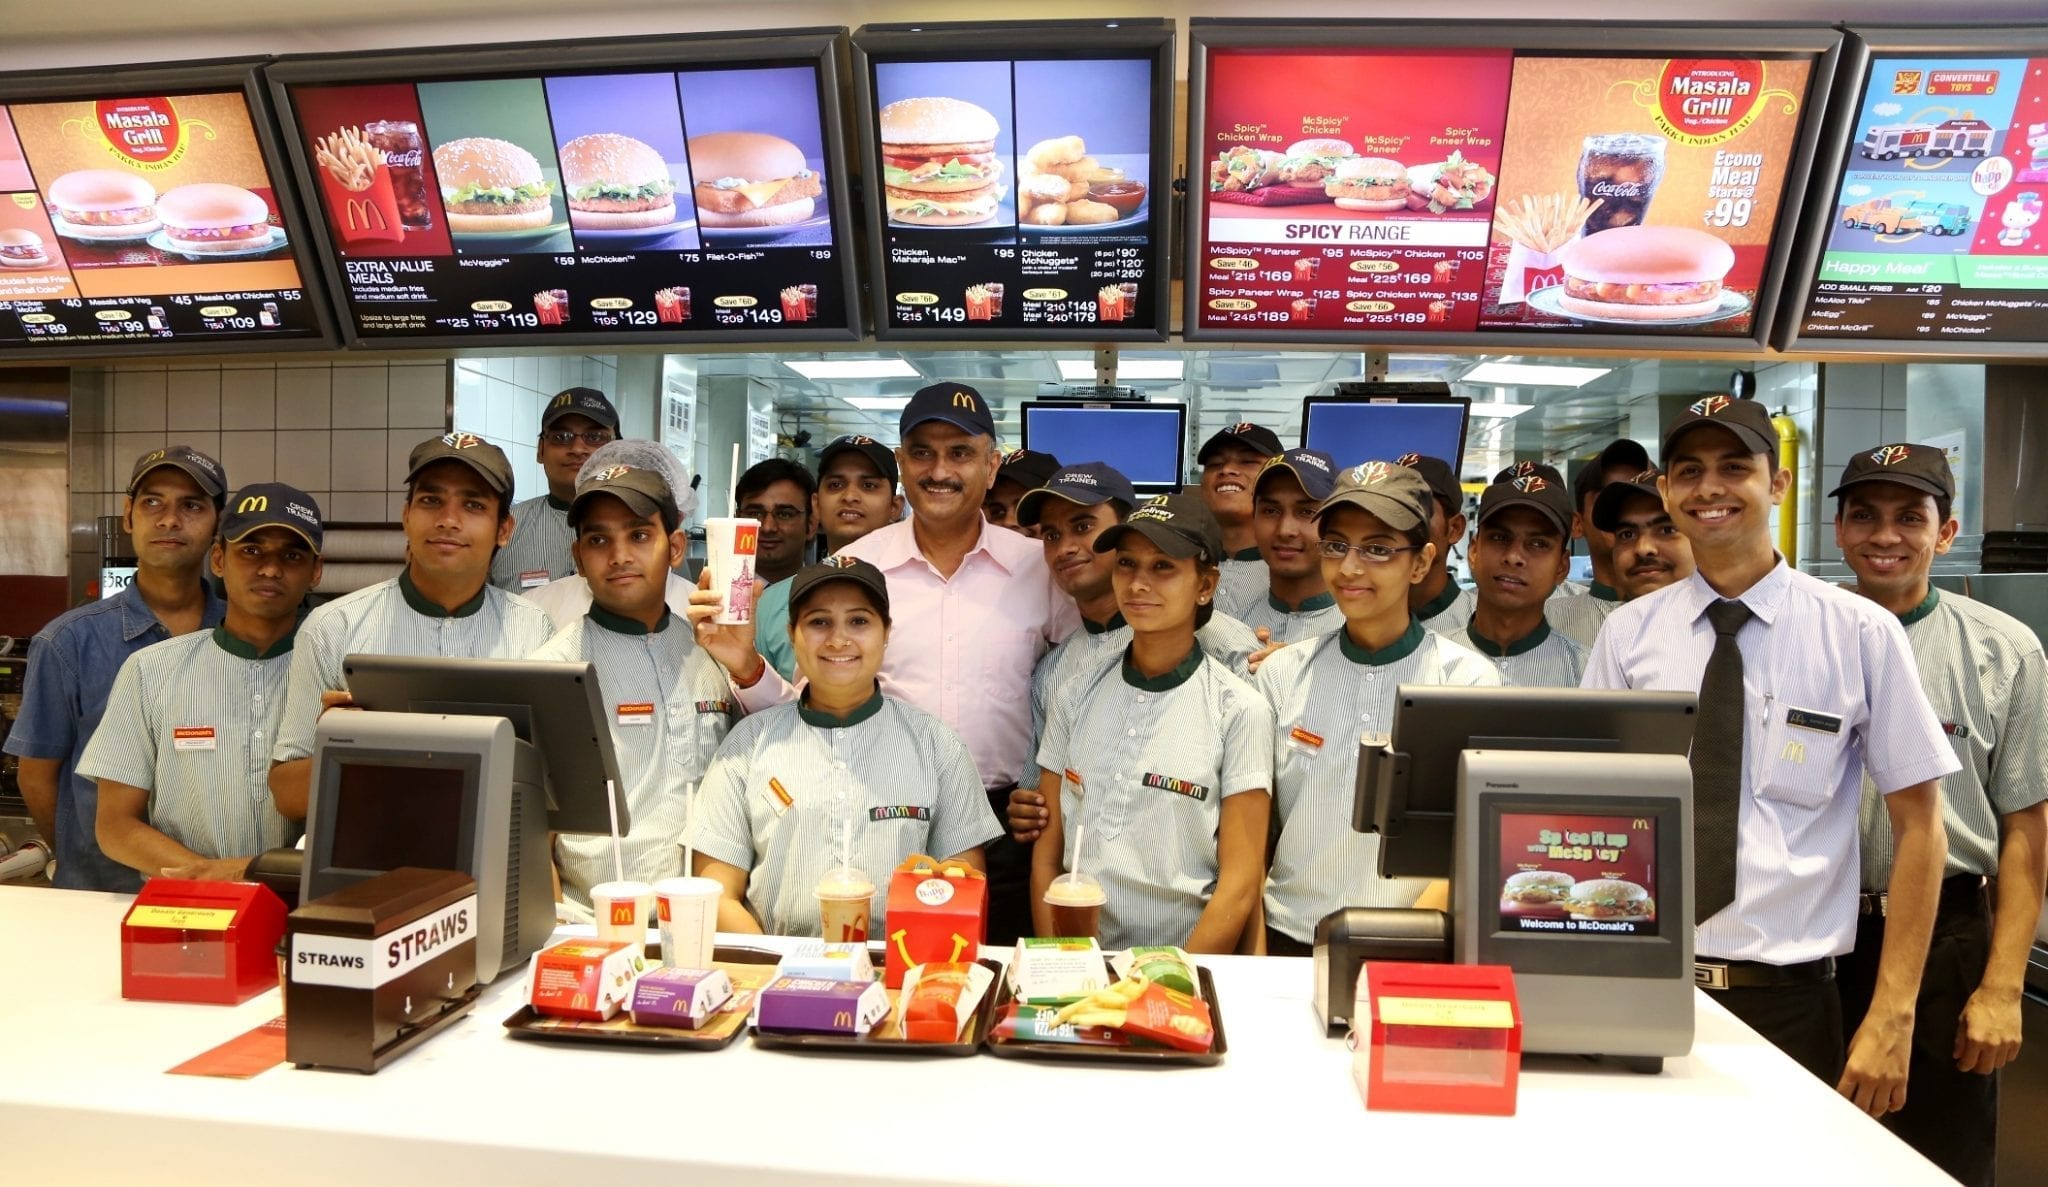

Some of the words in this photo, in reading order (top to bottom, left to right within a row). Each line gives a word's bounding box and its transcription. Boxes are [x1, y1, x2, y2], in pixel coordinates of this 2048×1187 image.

[1934, 73, 1991, 82] CONVERTIBLE
[1669, 76, 1751, 96] Masala
[1950, 83, 1972, 92] TOYS
[1682, 97, 1733, 116] Grill
[105, 111, 170, 128] Masala
[1302, 125, 1341, 134] Chicken
[1654, 115, 1685, 142] PAKKA
[1688, 135, 1726, 145] INDIAN
[123, 128, 164, 145] Grill
[1217, 132, 1255, 142] Chicken
[1259, 133, 1283, 143] Wrap
[1430, 136, 1464, 145] Paneer
[1467, 136, 1492, 147] Wrap
[1366, 144, 1401, 153] Paneer
[1714, 150, 1762, 167] Econo
[1711, 166, 1760, 186] Meal
[1707, 185, 1755, 199] Starts@
[1286, 224, 1343, 239] SPICY
[1349, 225, 1412, 240] RANGE
[810, 250, 831, 260] ₹89
[892, 248, 929, 256] Chicken
[994, 248, 1015, 258] ₹95
[1021, 249, 1059, 257] Chicken
[1264, 247, 1301, 256] Paneer
[1322, 248, 1344, 257] ₹95
[1404, 249, 1445, 258] Chicken
[1456, 250, 1484, 260] ₹105
[679, 253, 700, 263] ₹75
[892, 256, 935, 265] Maharaja
[1217, 259, 1236, 267] Save
[346, 261, 388, 273] EXTRA
[391, 259, 434, 272] VALUE
[1356, 262, 1376, 270] Save
[1825, 261, 1881, 275] Happy
[350, 272, 394, 284] MEALS
[1260, 271, 1292, 281] ₹169
[1397, 273, 1431, 283] ₹169
[1208, 287, 1236, 297] Spicy
[1238, 288, 1274, 297] Paneer
[1276, 289, 1303, 299] Wrap
[1313, 289, 1341, 299] ₹125
[1818, 283, 1837, 291] ADD
[1838, 284, 1868, 292] SMALL
[1922, 284, 1942, 293] ₹20
[195, 294, 224, 302] Masala
[225, 293, 241, 301] Grill
[242, 291, 275, 299] Chicken
[396, 292, 409, 300] soft
[410, 292, 427, 300] drink
[902, 295, 919, 303] Save
[1029, 290, 1046, 298] Save
[1346, 290, 1373, 299] Spicy
[1375, 290, 1416, 299] Chicken
[1418, 291, 1446, 301] Wrap
[1451, 291, 1478, 301] ₹135
[89, 298, 118, 306] Masala
[136, 297, 152, 306] Veg
[595, 299, 613, 307] Save
[720, 298, 738, 306] Save
[1215, 300, 1235, 308] Save
[1815, 296, 1846, 304] McAloo
[1951, 299, 1984, 307] Chicken
[476, 302, 493, 310] Save
[1068, 301, 1097, 312] ₹149
[1353, 302, 1372, 311] Save
[392, 314, 409, 322] large
[619, 310, 658, 325] ₹129
[743, 308, 782, 323] ₹149
[925, 307, 966, 322] ₹149
[1068, 312, 1096, 322] ₹179
[1257, 311, 1289, 321] ₹189
[1393, 312, 1426, 323] ₹189
[500, 313, 538, 327] ₹119
[376, 322, 393, 330] large
[395, 321, 408, 329] soft
[1294, 455, 1330, 473] TRAINER
[1299, 453, 1327, 466] CREW
[1058, 477, 1098, 487] TRAINER
[289, 501, 313, 517] CREW
[285, 506, 319, 527] TRAINER
[1486, 781, 1519, 789] Panasonic
[1520, 919, 1565, 929] Welcome
[1566, 921, 1576, 930] to
[1578, 921, 1635, 932] McDonald's
[388, 908, 468, 969] STRAWS
[298, 951, 365, 969] STRAWS
